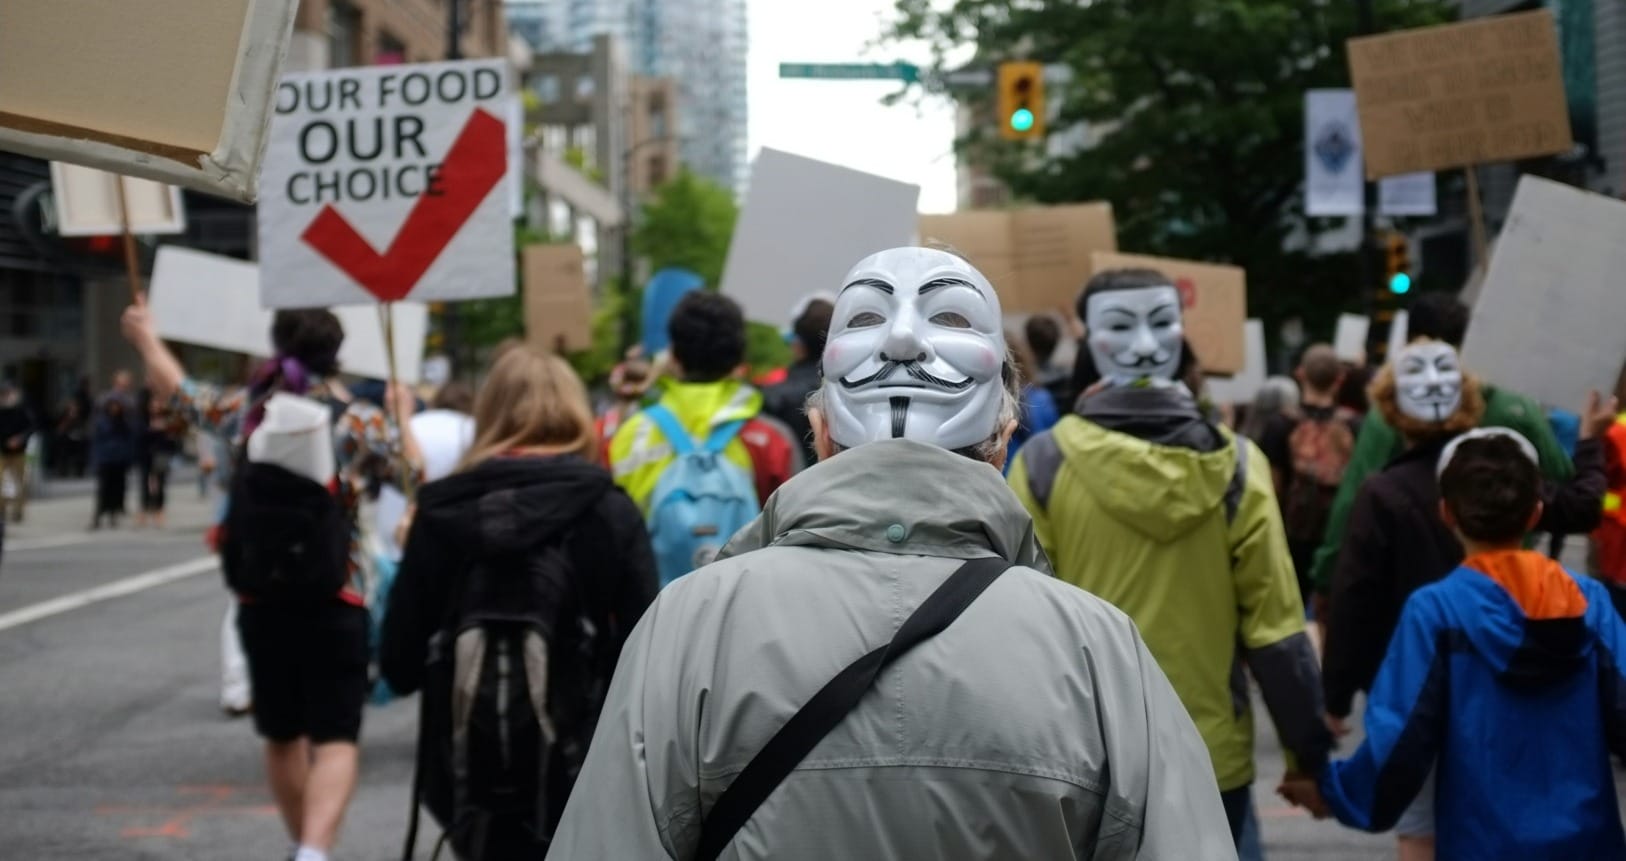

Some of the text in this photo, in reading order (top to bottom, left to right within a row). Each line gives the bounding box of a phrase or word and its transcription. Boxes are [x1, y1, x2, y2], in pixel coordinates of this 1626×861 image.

[275, 67, 501, 115] OUR FOOD
[299, 115, 427, 164] OUR
[287, 164, 446, 204] CHOICE
